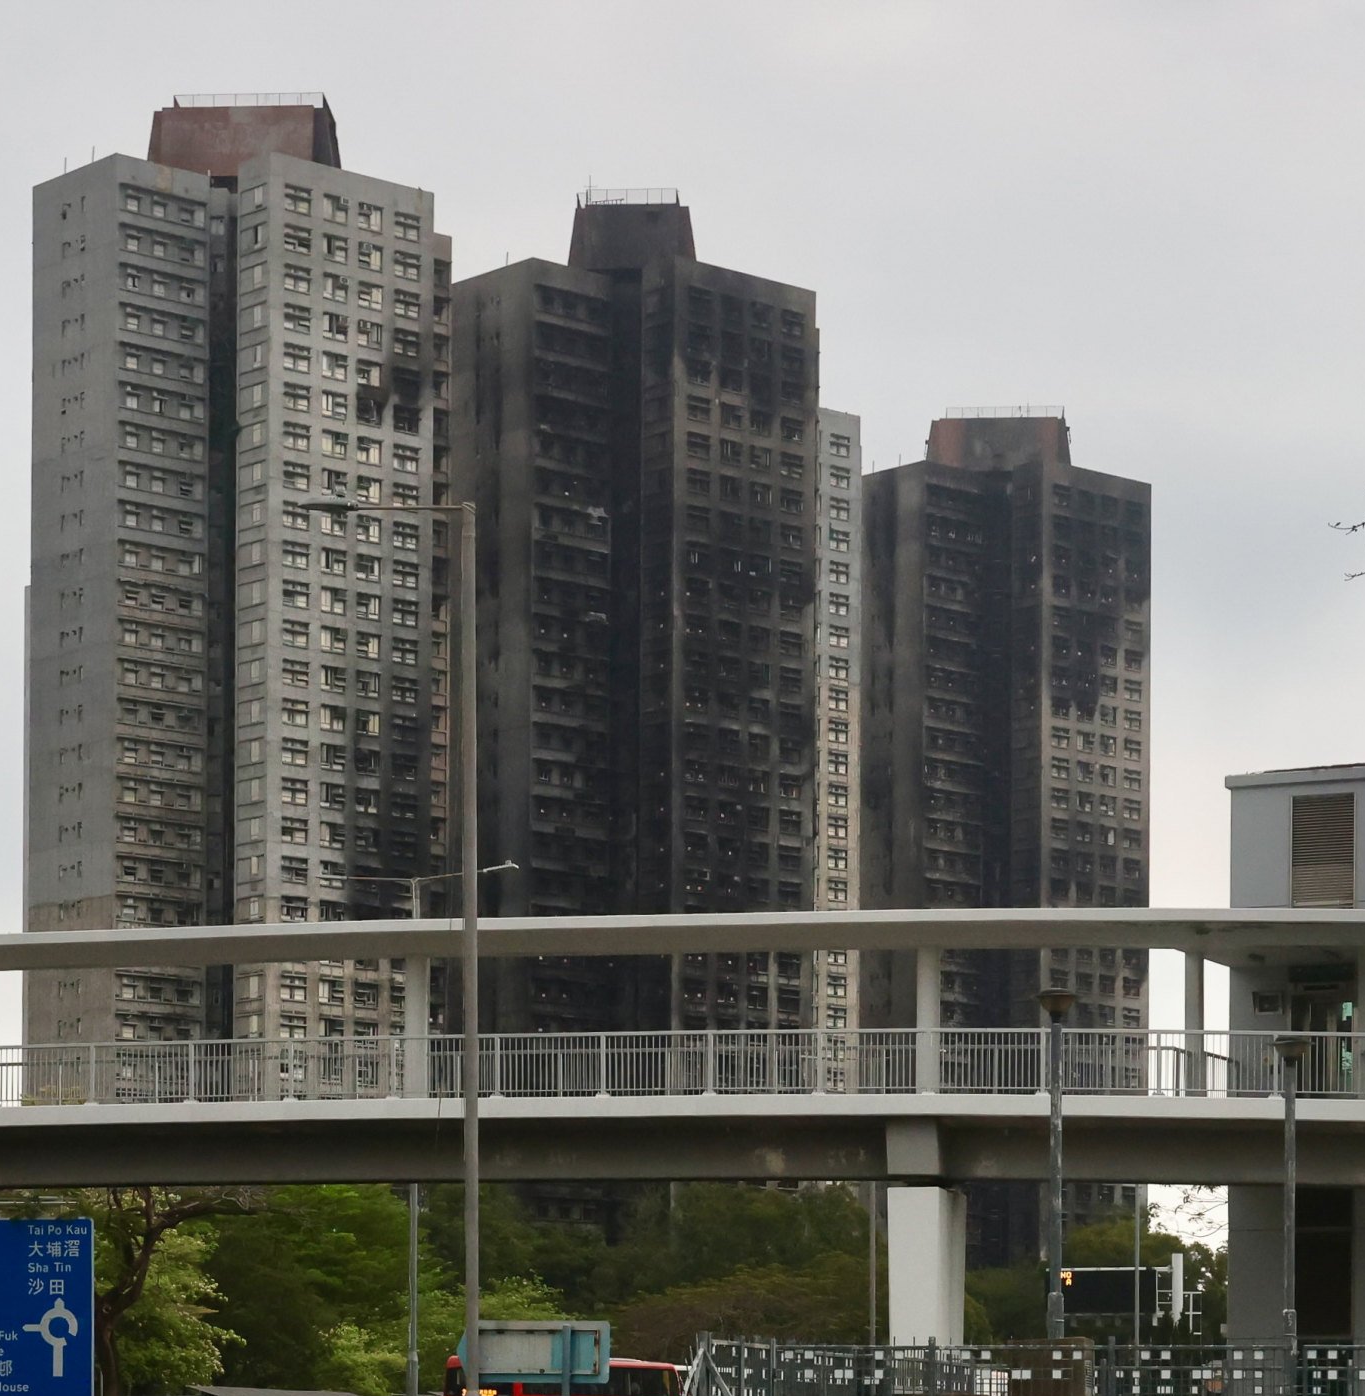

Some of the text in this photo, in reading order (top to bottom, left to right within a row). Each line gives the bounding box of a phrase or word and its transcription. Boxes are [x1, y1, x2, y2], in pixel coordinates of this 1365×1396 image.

[28, 1225, 88, 1235] Tai Po Kau
[28, 1262, 72, 1273] Sha Tin
[28, 1278, 65, 1295] 沙田
